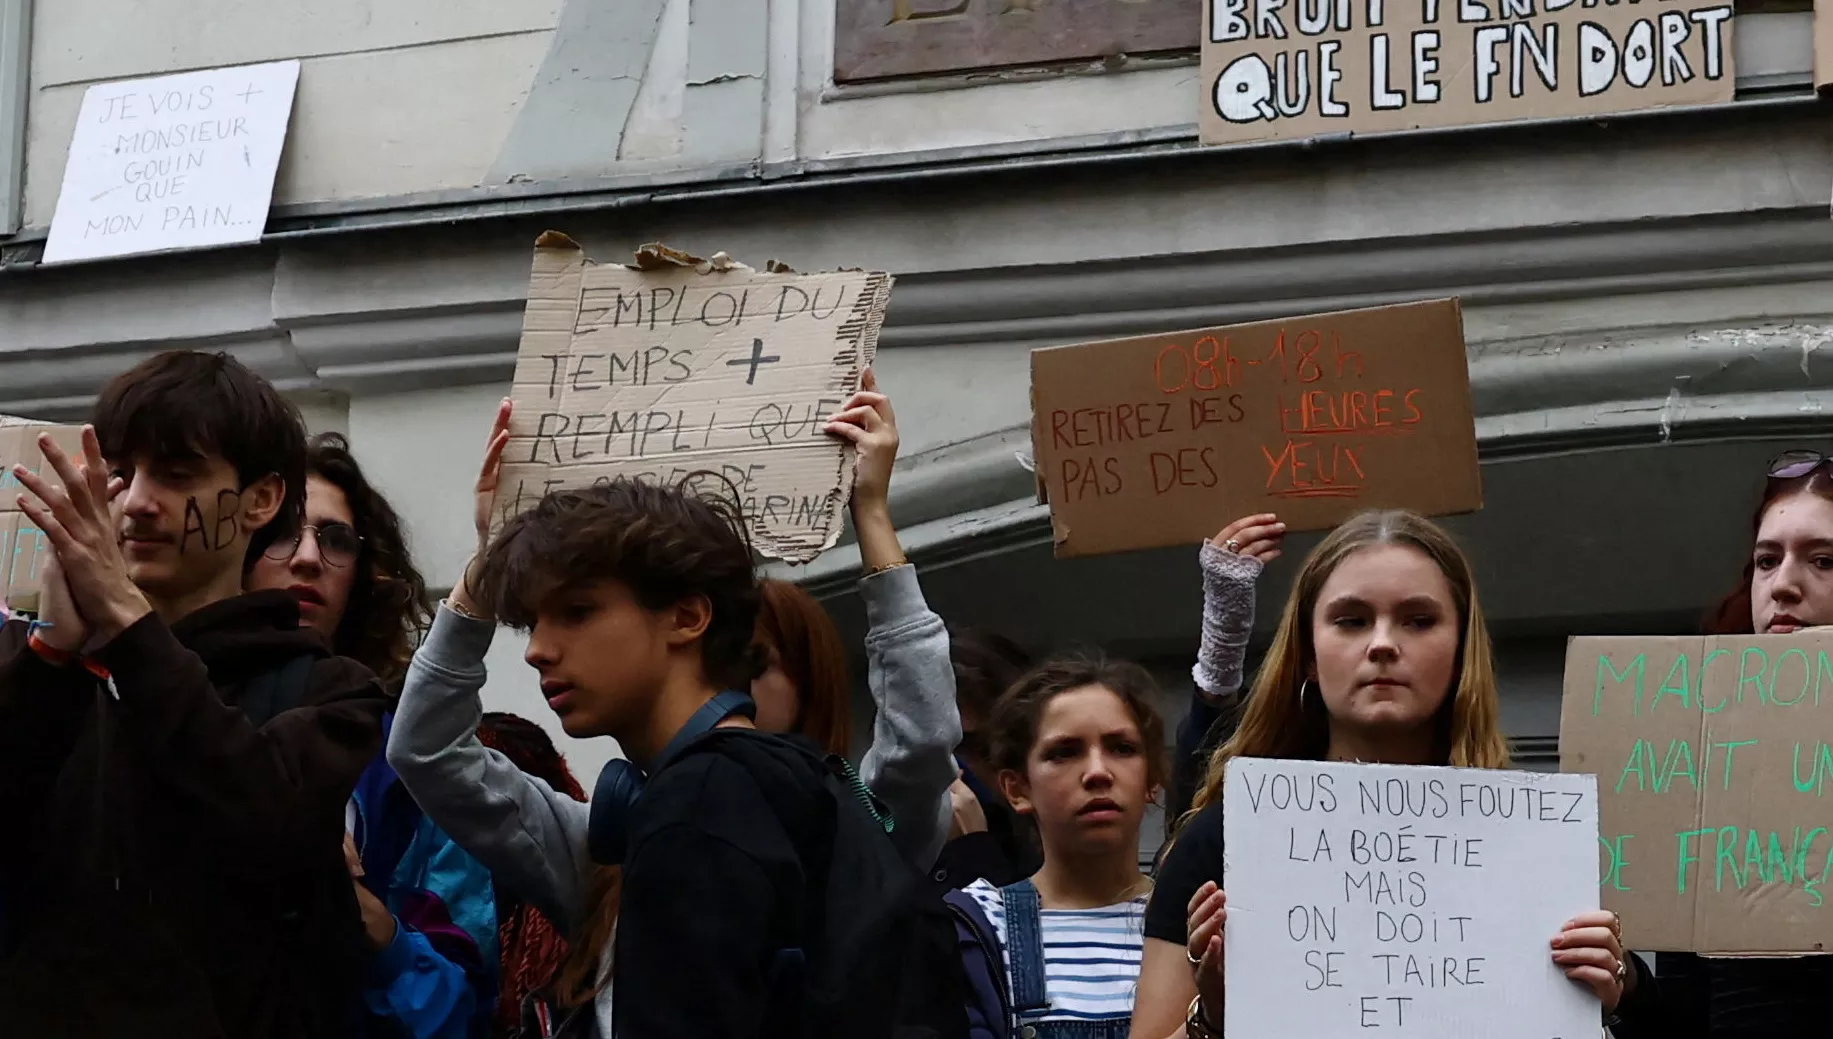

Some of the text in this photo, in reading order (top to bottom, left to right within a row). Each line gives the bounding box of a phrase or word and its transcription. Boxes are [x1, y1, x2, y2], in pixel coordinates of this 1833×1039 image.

[1212, 5, 1732, 123] QUE LE FN DORT
[99, 93, 138, 123] JE
[115, 116, 249, 153] MONSIEUR
[124, 149, 204, 184] GOUIN
[135, 175, 188, 202] QUE
[84, 214, 143, 239] MON
[775, 284, 845, 323] DU
[541, 345, 692, 398] TEMPS
[750, 399, 843, 445] QUE
[1190, 394, 1245, 431] DES
[1277, 388, 1423, 431] HEURES
[722, 464, 766, 493] DE
[1062, 440, 1365, 503] PAS DES YEUX
[180, 488, 241, 553] AB
[1242, 772, 1583, 823] VOUS NOUS FOUTEZ
[1289, 827, 1332, 863] LA
[1288, 905, 1336, 942] ON
[1305, 949, 1346, 991] SE
[1360, 996, 1413, 1027] ET
